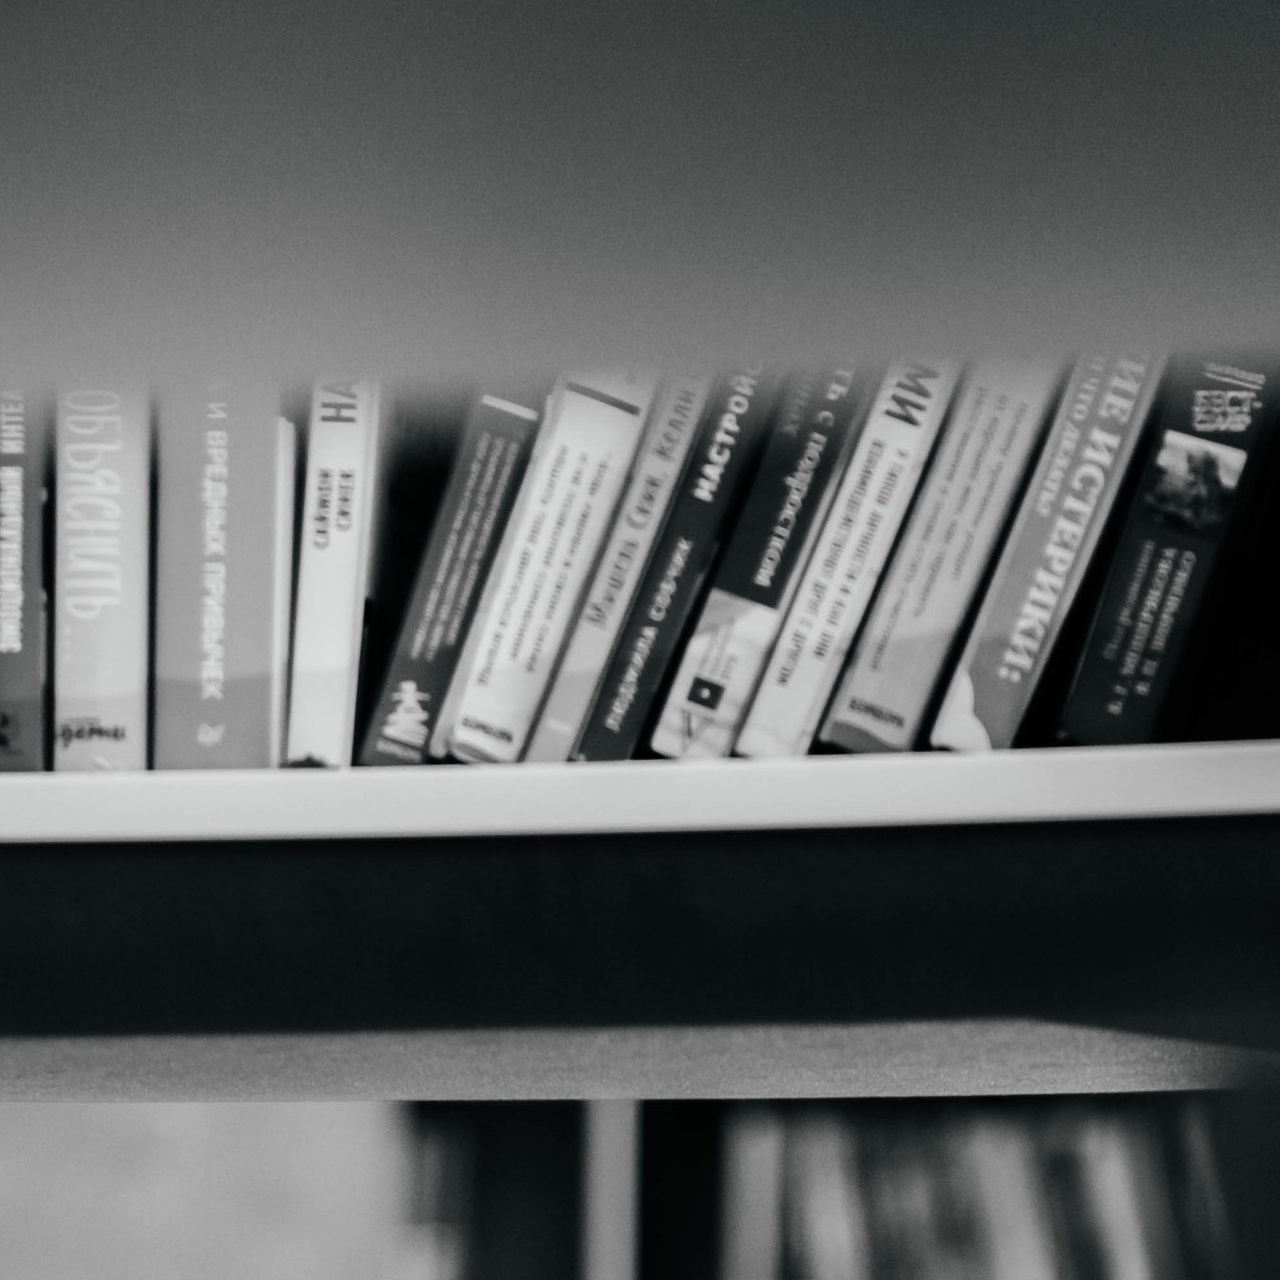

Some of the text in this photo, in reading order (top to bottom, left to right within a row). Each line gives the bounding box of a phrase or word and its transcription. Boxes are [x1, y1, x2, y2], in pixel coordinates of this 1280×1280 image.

[815, 408, 835, 427] с
[202, 430, 228, 557] ВРЕДНЫХ
[752, 429, 829, 589] подростком
[995, 425, 1122, 686] ИСТЕРИКИ:
[201, 561, 227, 700] ПРИВЫЧЕК
[602, 623, 660, 734] ЛЮДМИЛА
